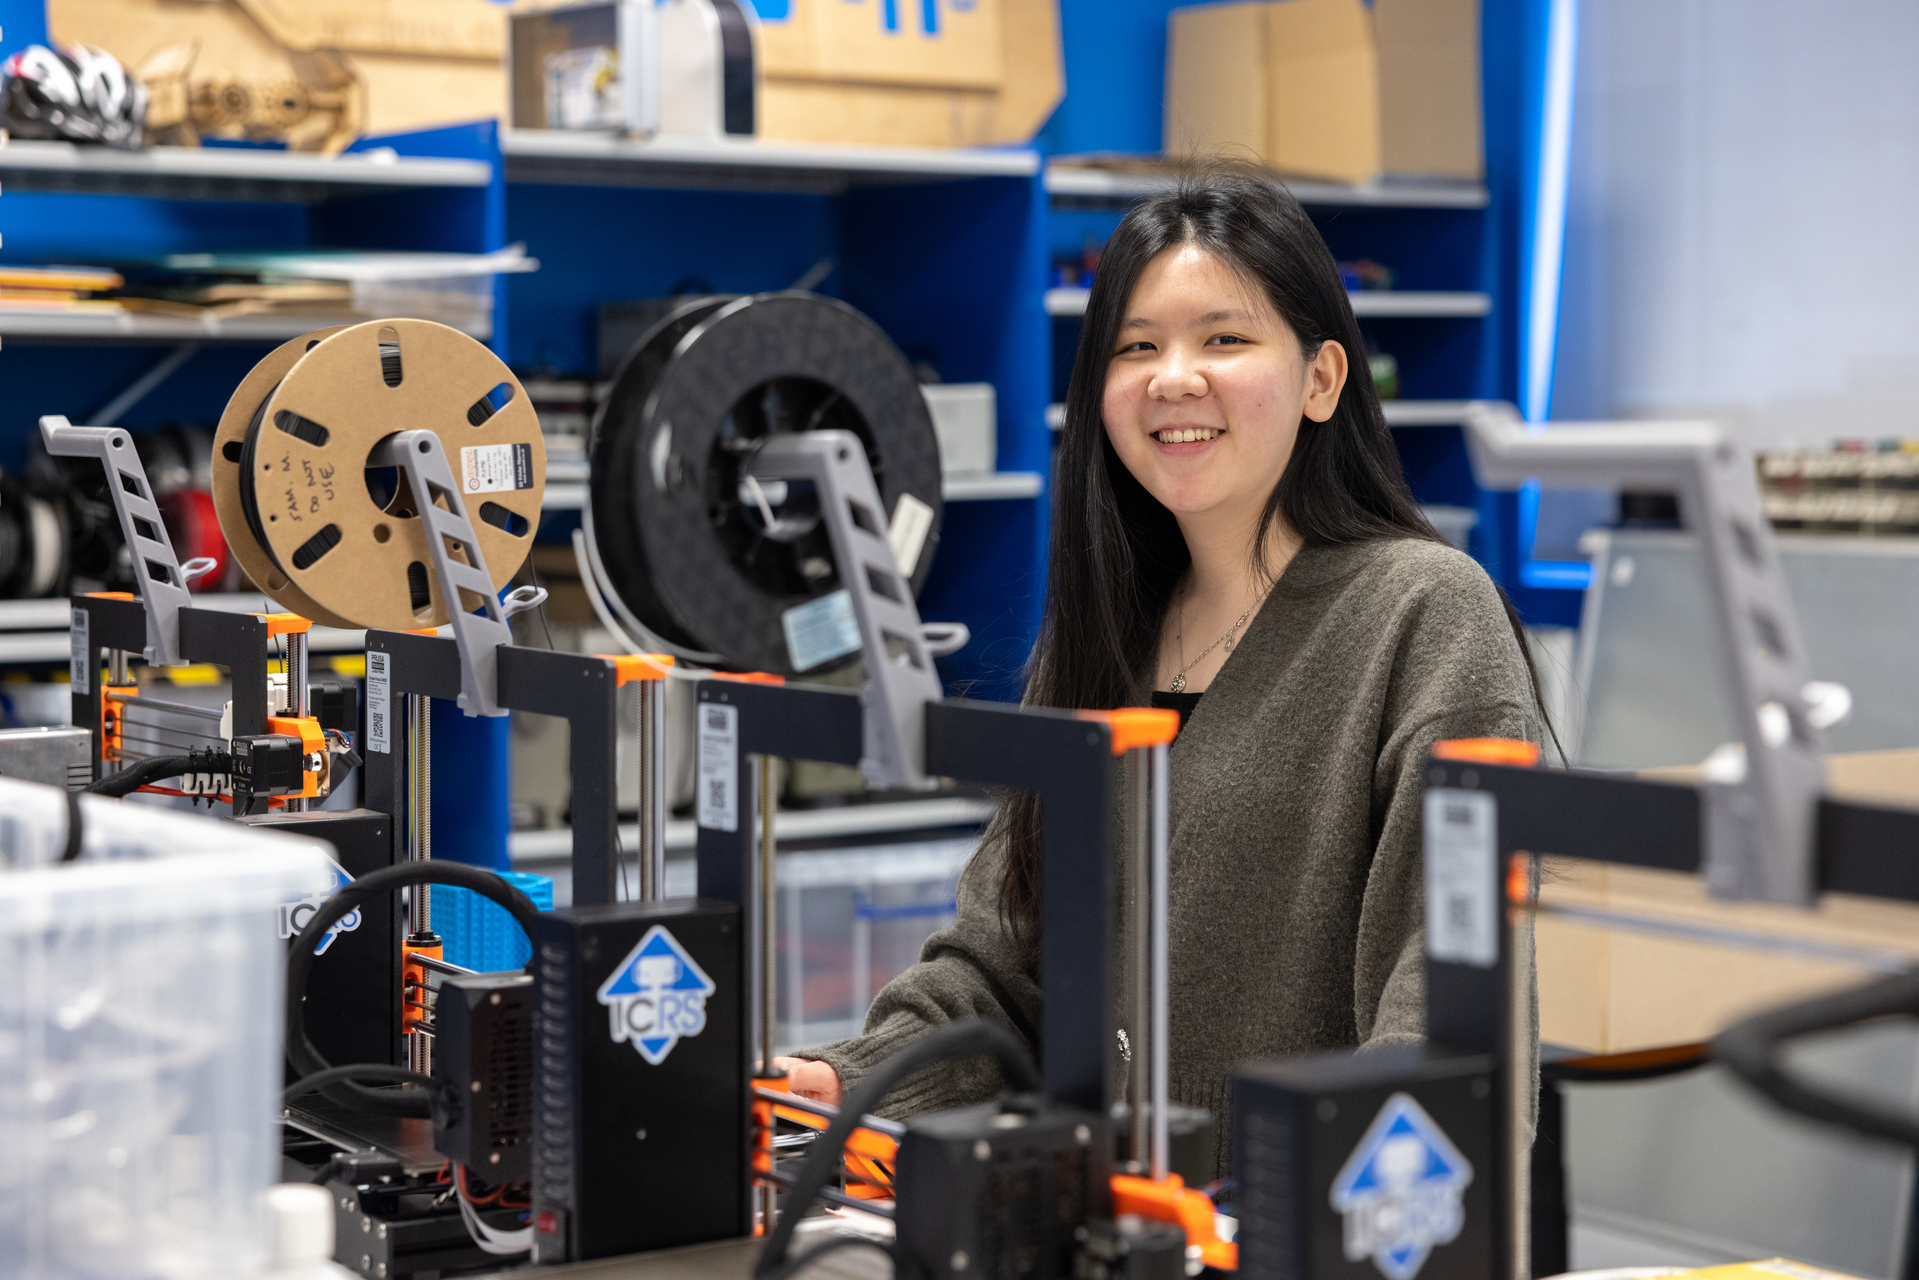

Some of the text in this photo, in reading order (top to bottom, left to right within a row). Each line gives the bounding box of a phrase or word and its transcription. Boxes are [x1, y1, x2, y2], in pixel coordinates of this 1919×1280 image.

[301, 458, 321, 514] DO NOT
[318, 461, 335, 501] USE
[371, 653, 385, 662] PRUSA
[236, 741, 248, 749] PRUSA
[616, 992, 704, 1034] ICRS
